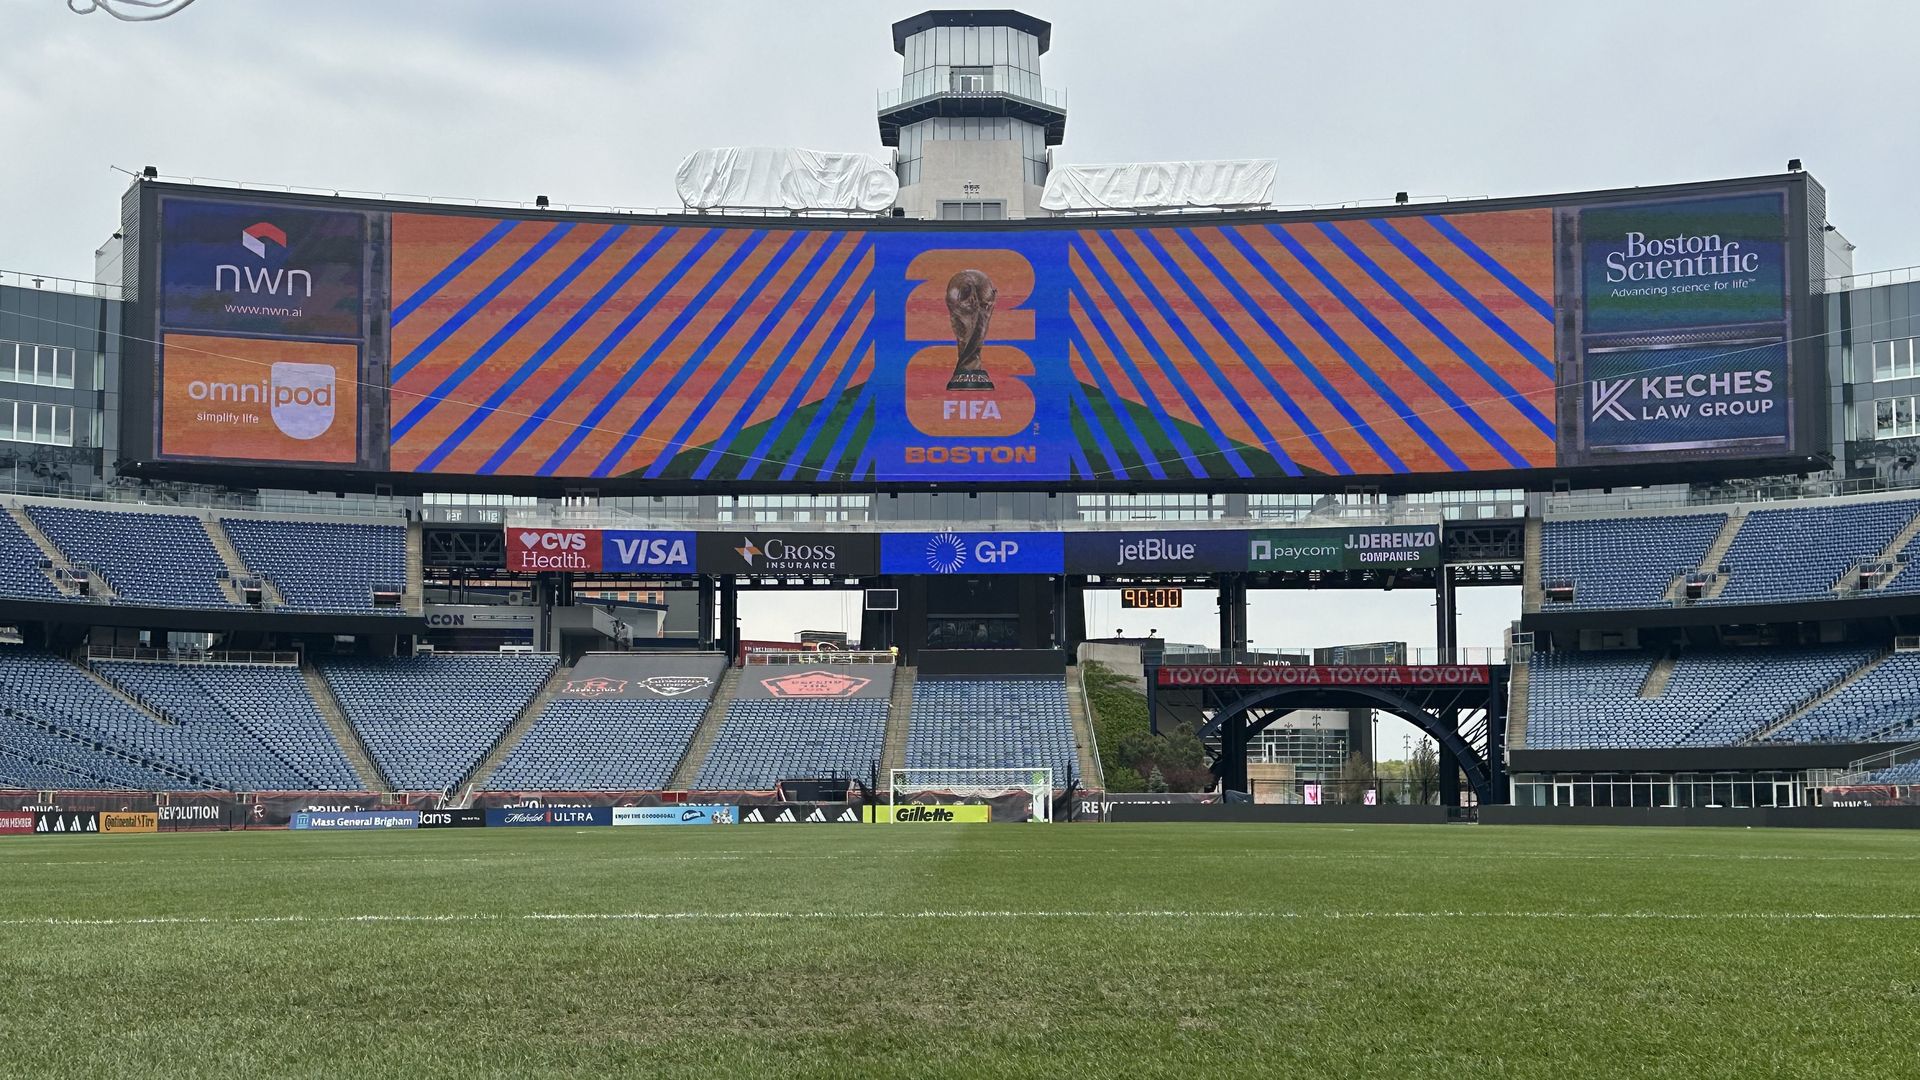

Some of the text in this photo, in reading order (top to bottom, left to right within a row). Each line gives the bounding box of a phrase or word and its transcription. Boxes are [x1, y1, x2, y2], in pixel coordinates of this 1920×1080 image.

[1625, 231, 1722, 258] Boston
[1606, 241, 1759, 283] Scientific
[215, 264, 312, 298] nwn
[1610, 285, 1668, 297] Advancing
[1671, 282, 1711, 294] science
[1714, 280, 1729, 290] for
[225, 304, 302, 317] www.nwn.ai
[1642, 369, 1774, 399] KECHES
[196, 411, 259, 425] simplify life
[943, 400, 1002, 420] FIFA
[1642, 399, 1774, 421] LAW GROUP
[905, 446, 1037, 464] BOSTON
[541, 532, 587, 550] CVS
[1344, 531, 1436, 550] J.DERENZO
[610, 538, 689, 565] VISA
[1117, 538, 1195, 566] jetBlue
[1274, 546, 1336, 560] paycom
[1359, 551, 1420, 562] COMPANIES
[766, 562, 836, 570] INSURANCE
[1125, 589, 1179, 607] 90:00
[1167, 667, 1483, 684] TOYOTA TOYOTA TOYOTA TOYOTA
[158, 805, 219, 820] REVOLUTION
[554, 812, 594, 822] ULTRA
[896, 806, 954, 822] Gillette
[105, 814, 154, 831] Continental Tire
[311, 816, 413, 828] Mass General Brigham
